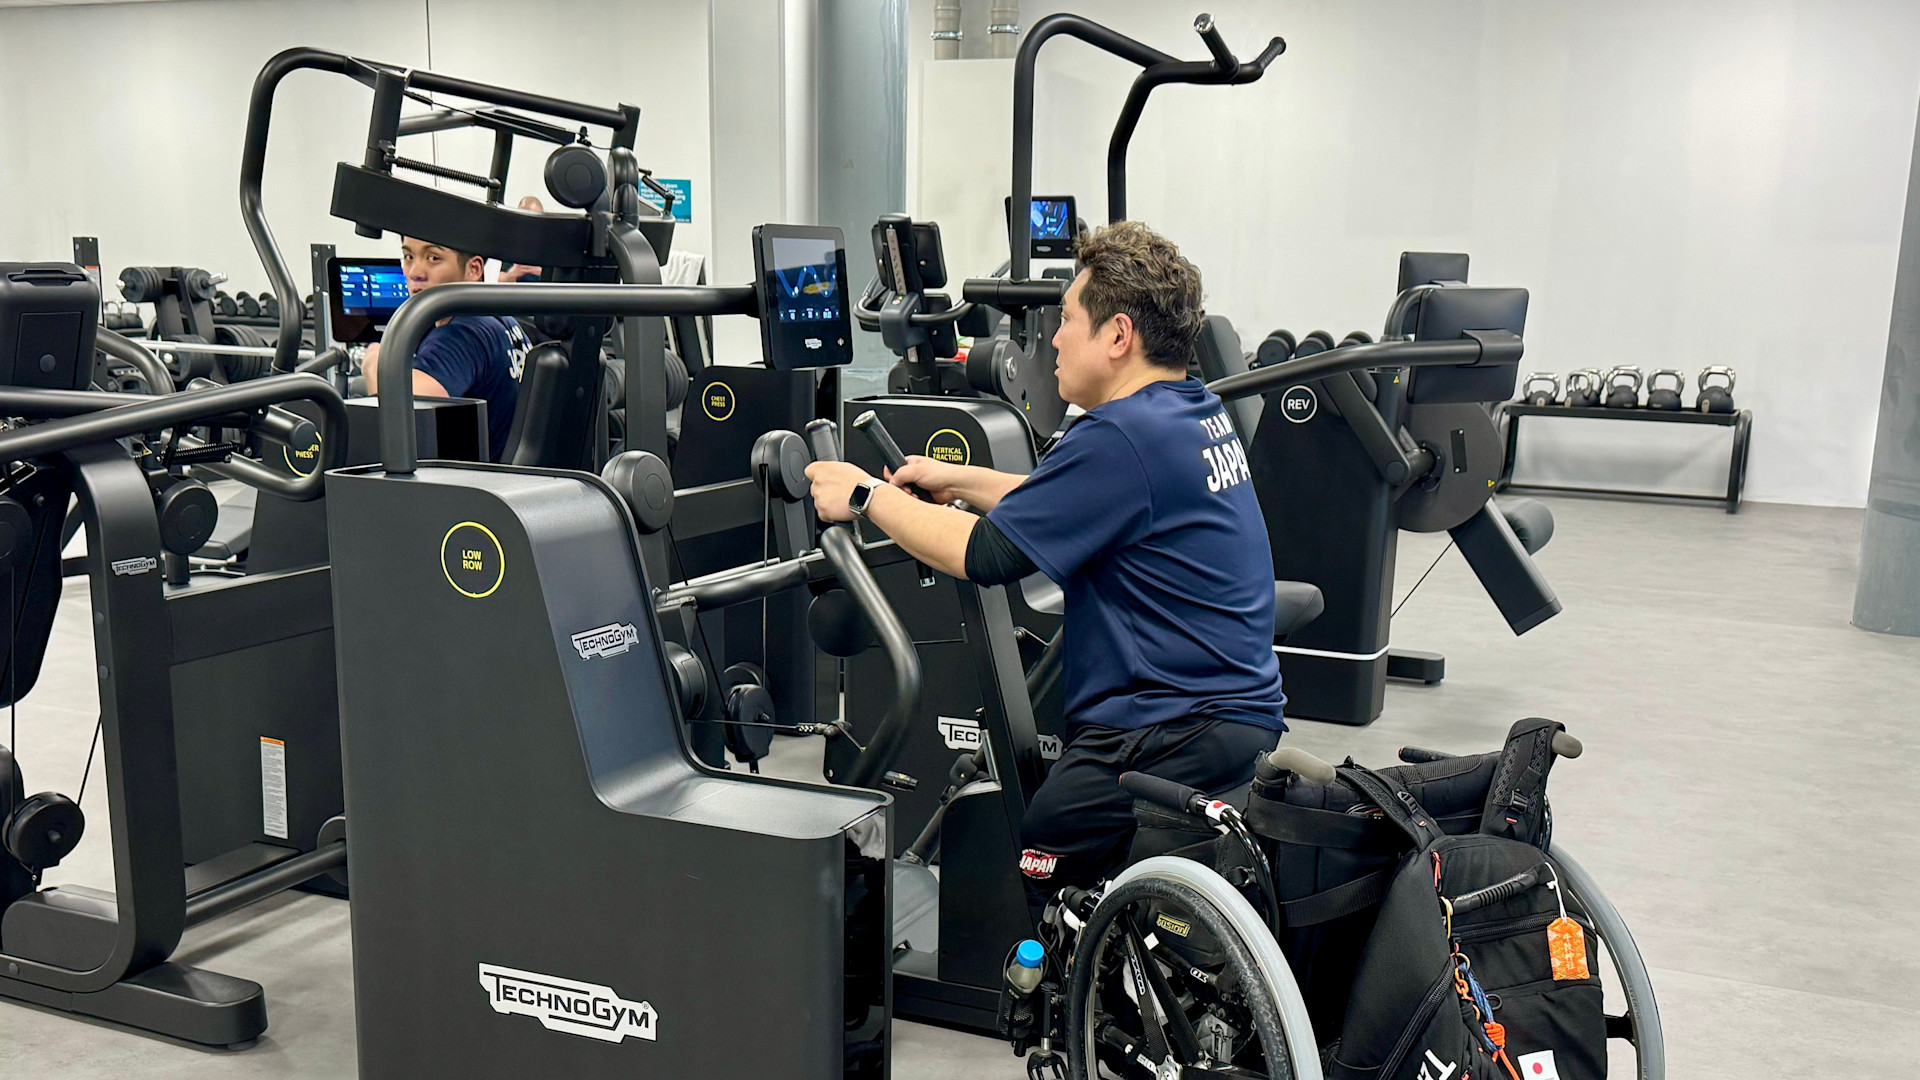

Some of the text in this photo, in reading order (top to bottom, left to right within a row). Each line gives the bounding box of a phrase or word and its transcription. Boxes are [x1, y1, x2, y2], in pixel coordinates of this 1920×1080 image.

[1287, 399, 1311, 410] REV
[1200, 412, 1233, 440] TEAM
[295, 450, 314, 459] PRESS
[932, 446, 963, 455] VERTICAL
[932, 453, 963, 462] TRACTION
[1202, 437, 1251, 493] JAPA
[462, 549, 482, 560] LOW
[462, 560, 483, 571] ROW
[1019, 855, 1058, 873] JAPAN
